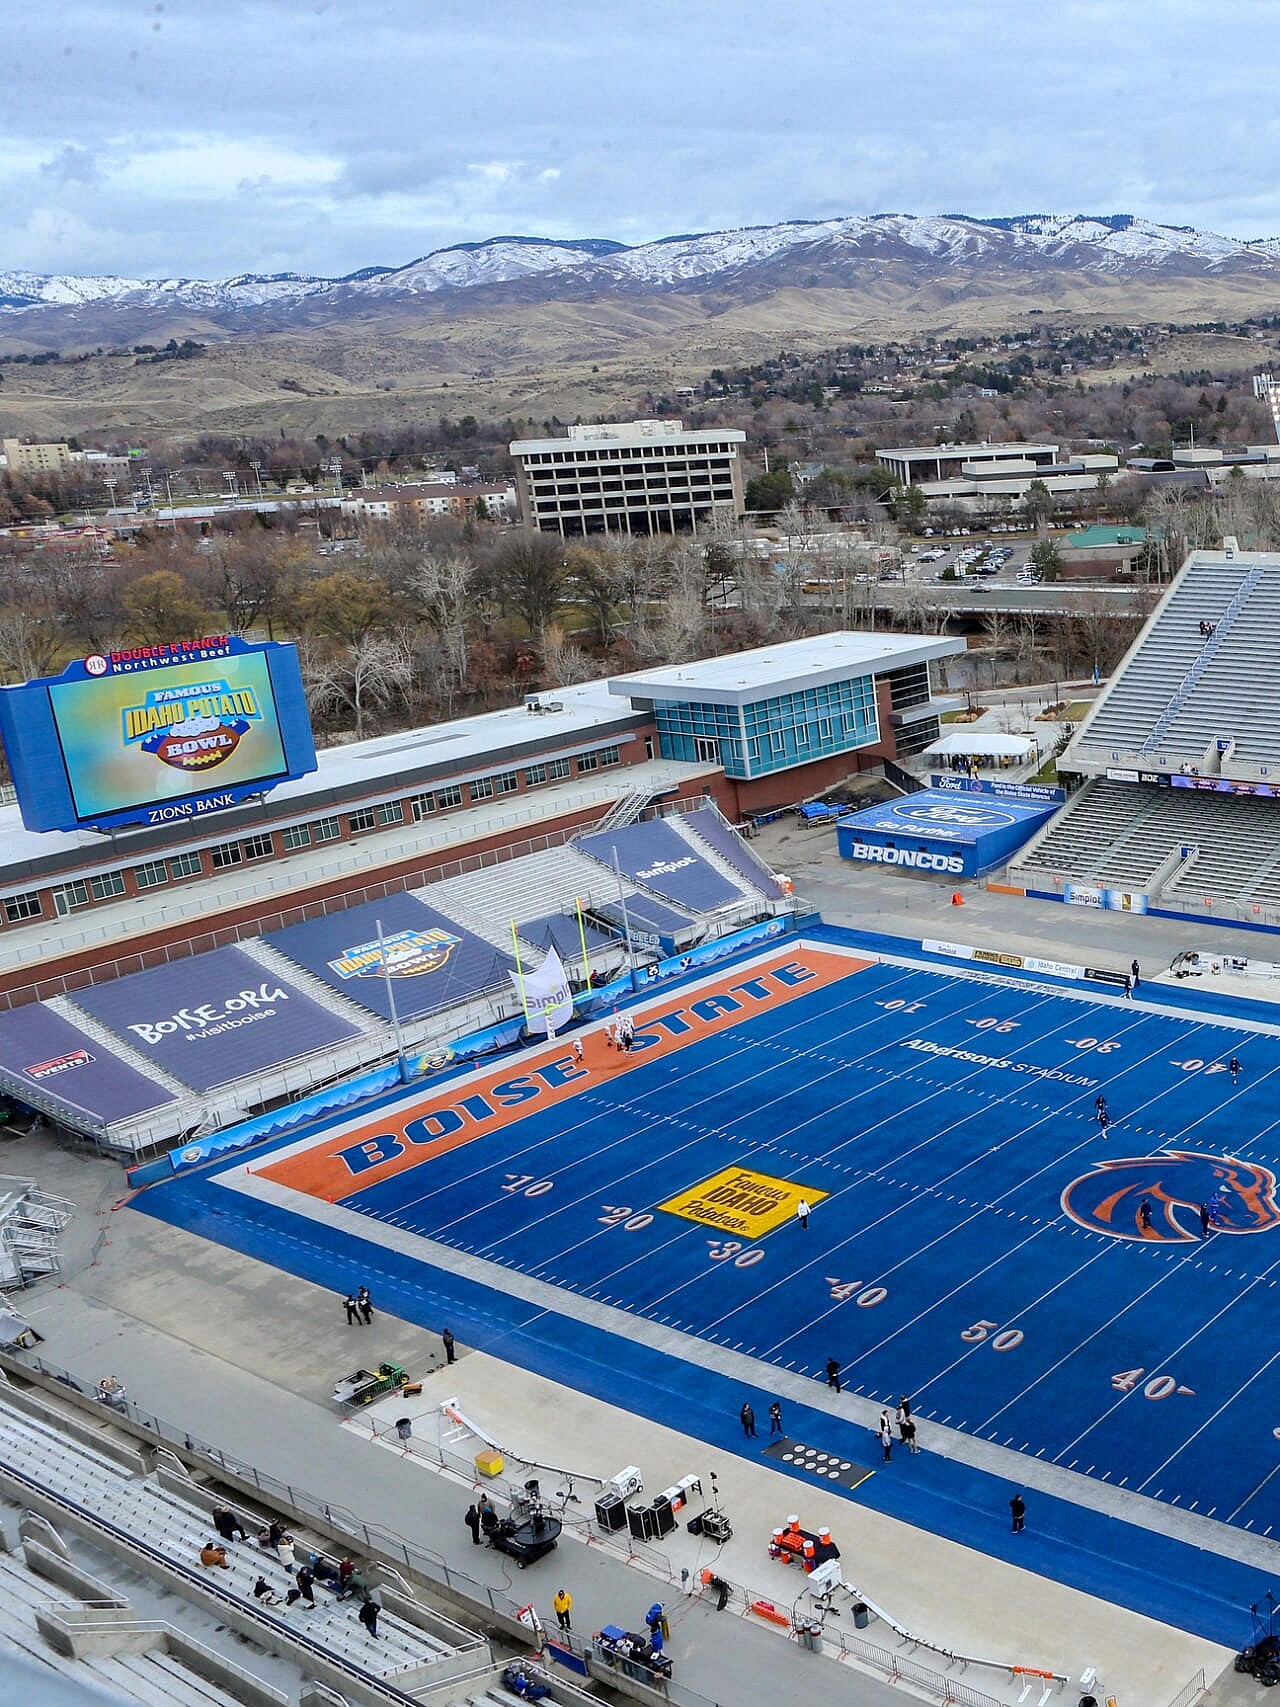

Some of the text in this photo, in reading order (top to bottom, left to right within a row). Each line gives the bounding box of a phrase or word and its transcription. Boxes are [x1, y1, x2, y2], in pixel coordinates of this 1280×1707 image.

[111, 636, 229, 663] DOUBLE R RANCH
[113, 646, 231, 673] Northwest Beef
[153, 683, 221, 703] FAMOUS
[127, 691, 256, 739] IDAHO POTATO
[166, 734, 232, 758] BOWL
[939, 776, 961, 790] Ford
[148, 793, 236, 823] ZIONS BANK
[910, 805, 995, 824] Ford
[876, 821, 961, 838] Go Further
[635, 856, 698, 880] Simplot
[851, 842, 964, 873] BRONCOS
[1069, 891, 1102, 905] Simplot
[648, 966, 659, 976] 25
[1038, 961, 1077, 974] Idaho Central
[127, 983, 289, 1045] BOISE.ORG
[623, 960, 819, 1054] STATE
[186, 1008, 277, 1042] #visitboise
[33, 1058, 84, 1079] EVENTS
[900, 1038, 1098, 1088] Albertsons STADIUM
[328, 1055, 590, 1175] BOISE
[501, 1175, 554, 1198] 10
[726, 1172, 792, 1202] Famous
[678, 1200, 746, 1230] Potatoes
[700, 1186, 779, 1217] IDAHO
[598, 1206, 655, 1231] 20
[709, 1240, 765, 1268] 30
[829, 1279, 888, 1308] 40
[960, 1319, 1024, 1352] 50
[1111, 1367, 1177, 1400] 40
